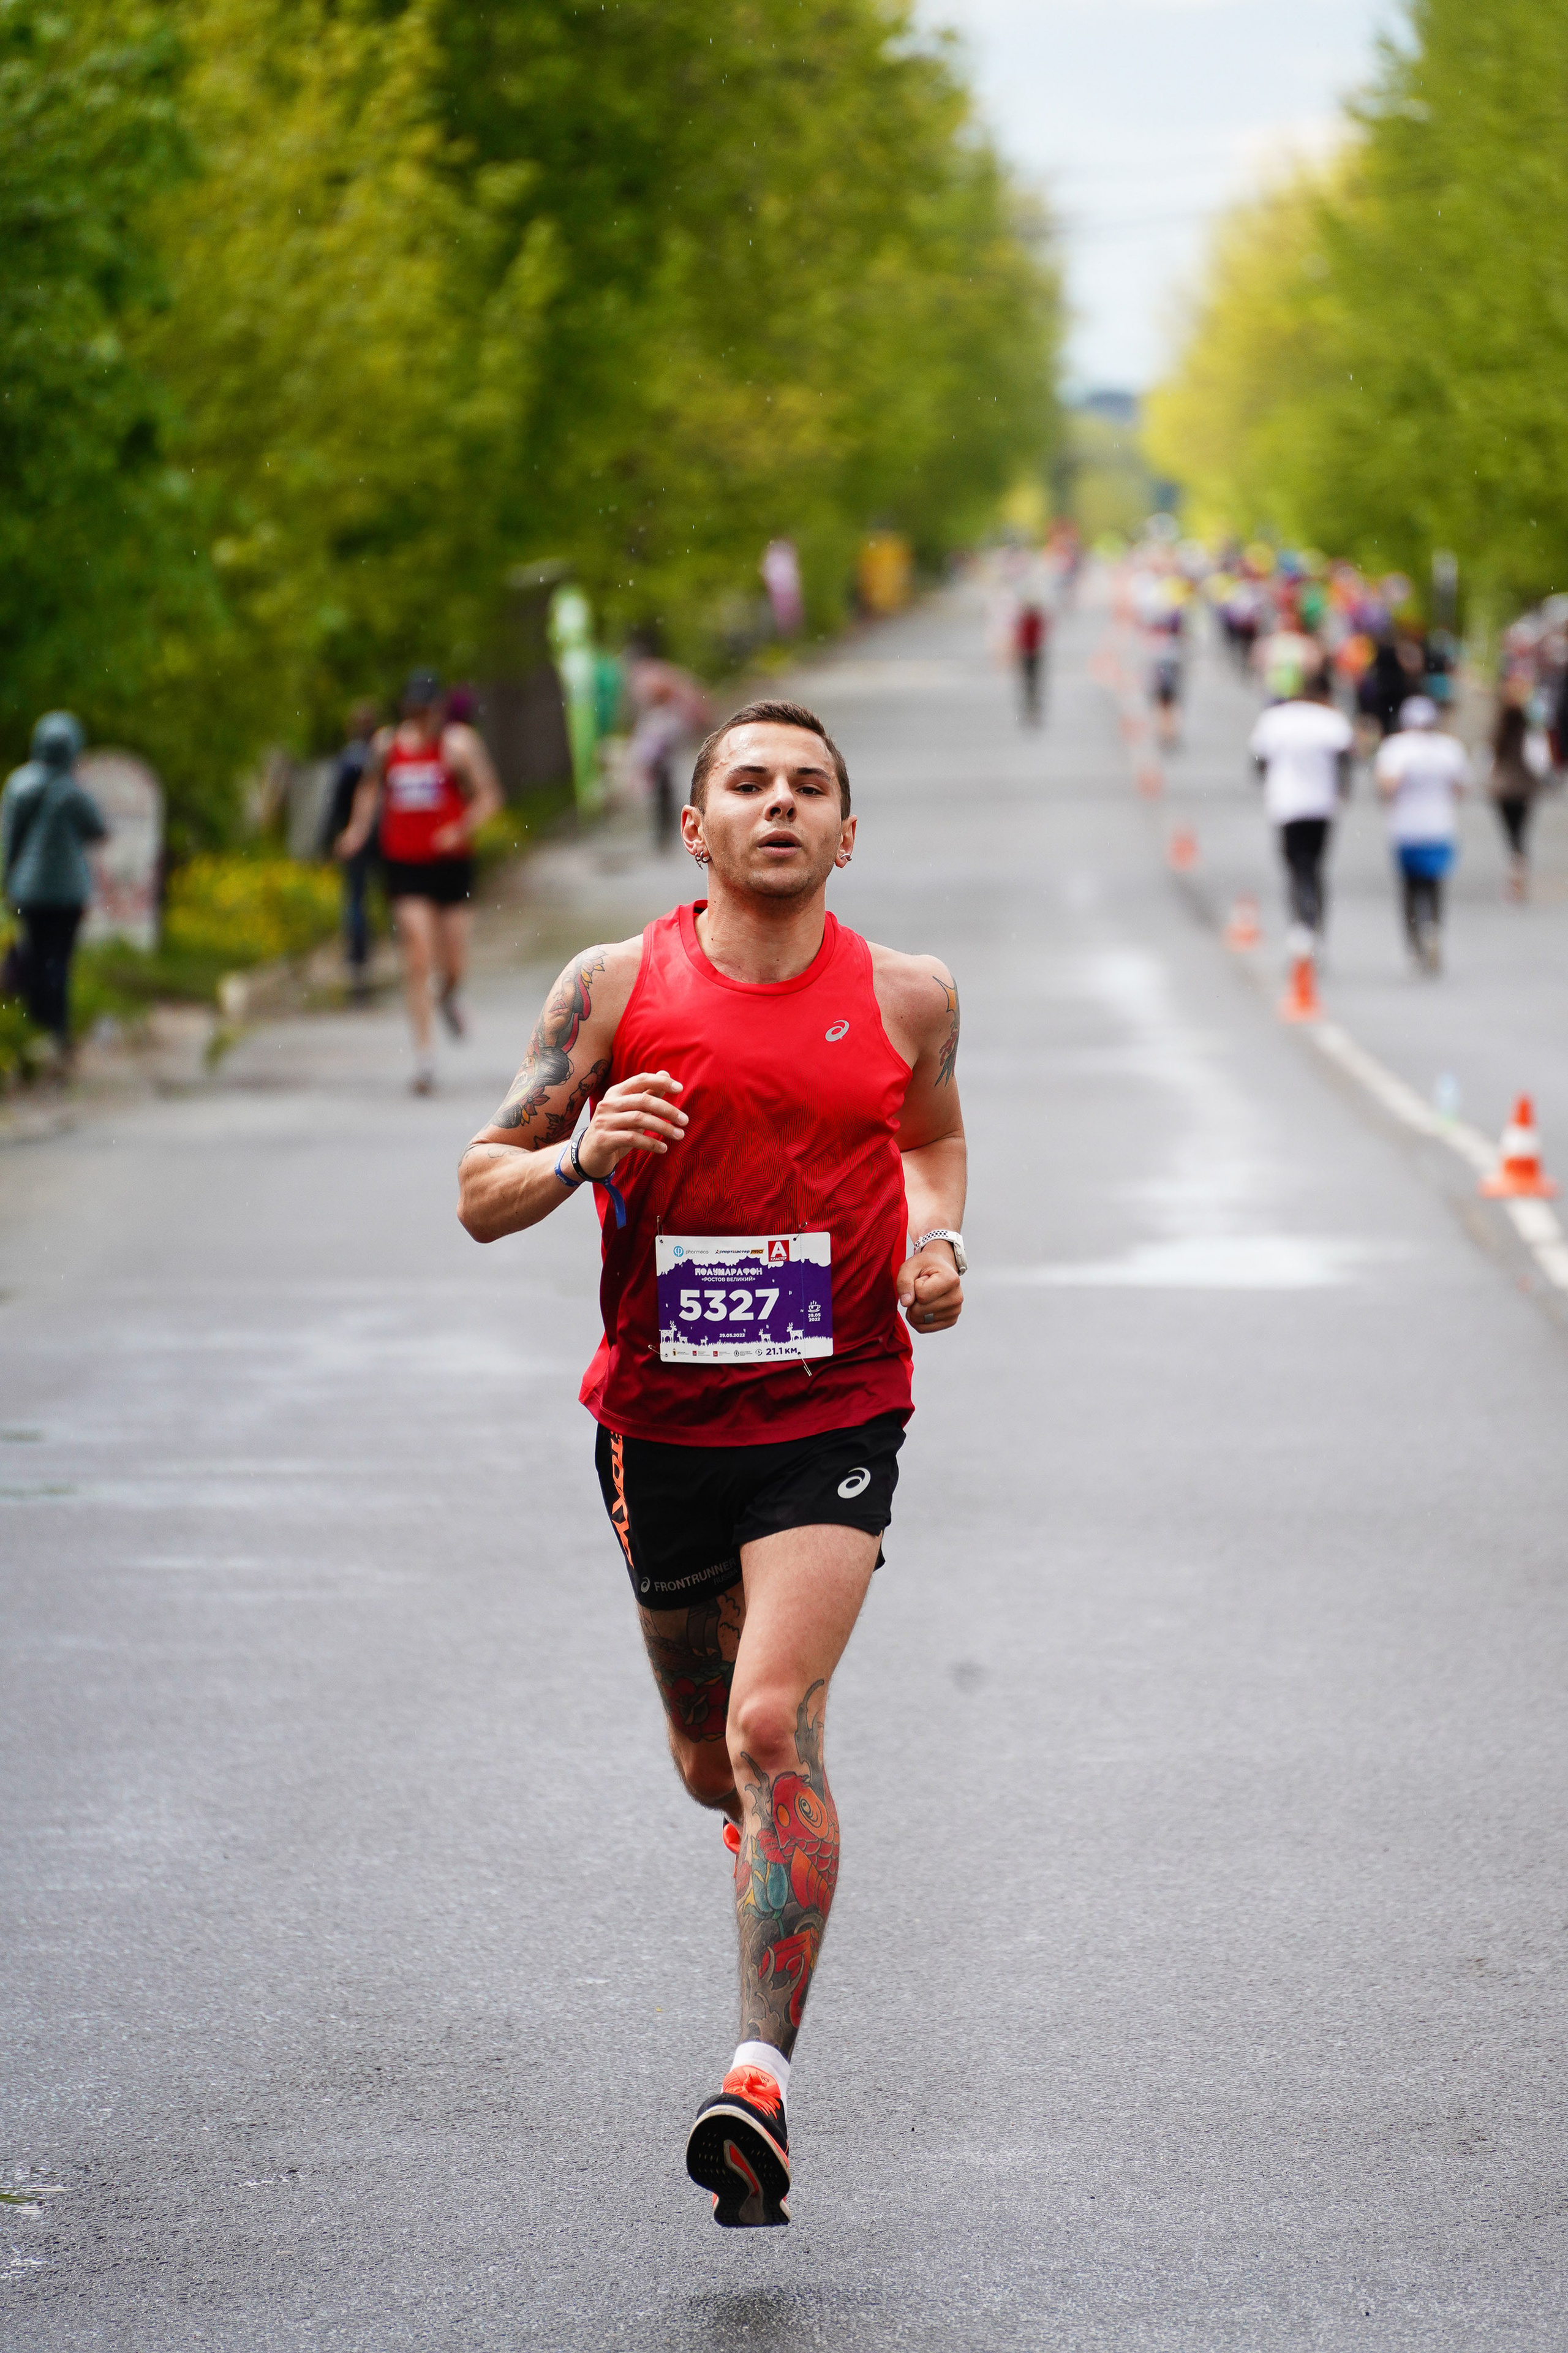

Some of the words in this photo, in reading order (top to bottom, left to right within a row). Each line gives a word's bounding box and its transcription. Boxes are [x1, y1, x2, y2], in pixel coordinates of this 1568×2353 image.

[695, 1267, 763, 1276] ПОЛУМАРАФОН
[679, 1288, 780, 1321] 5327
[766, 1347, 783, 1356] 21.1
[654, 1557, 737, 1592] FRONTRUNNER
